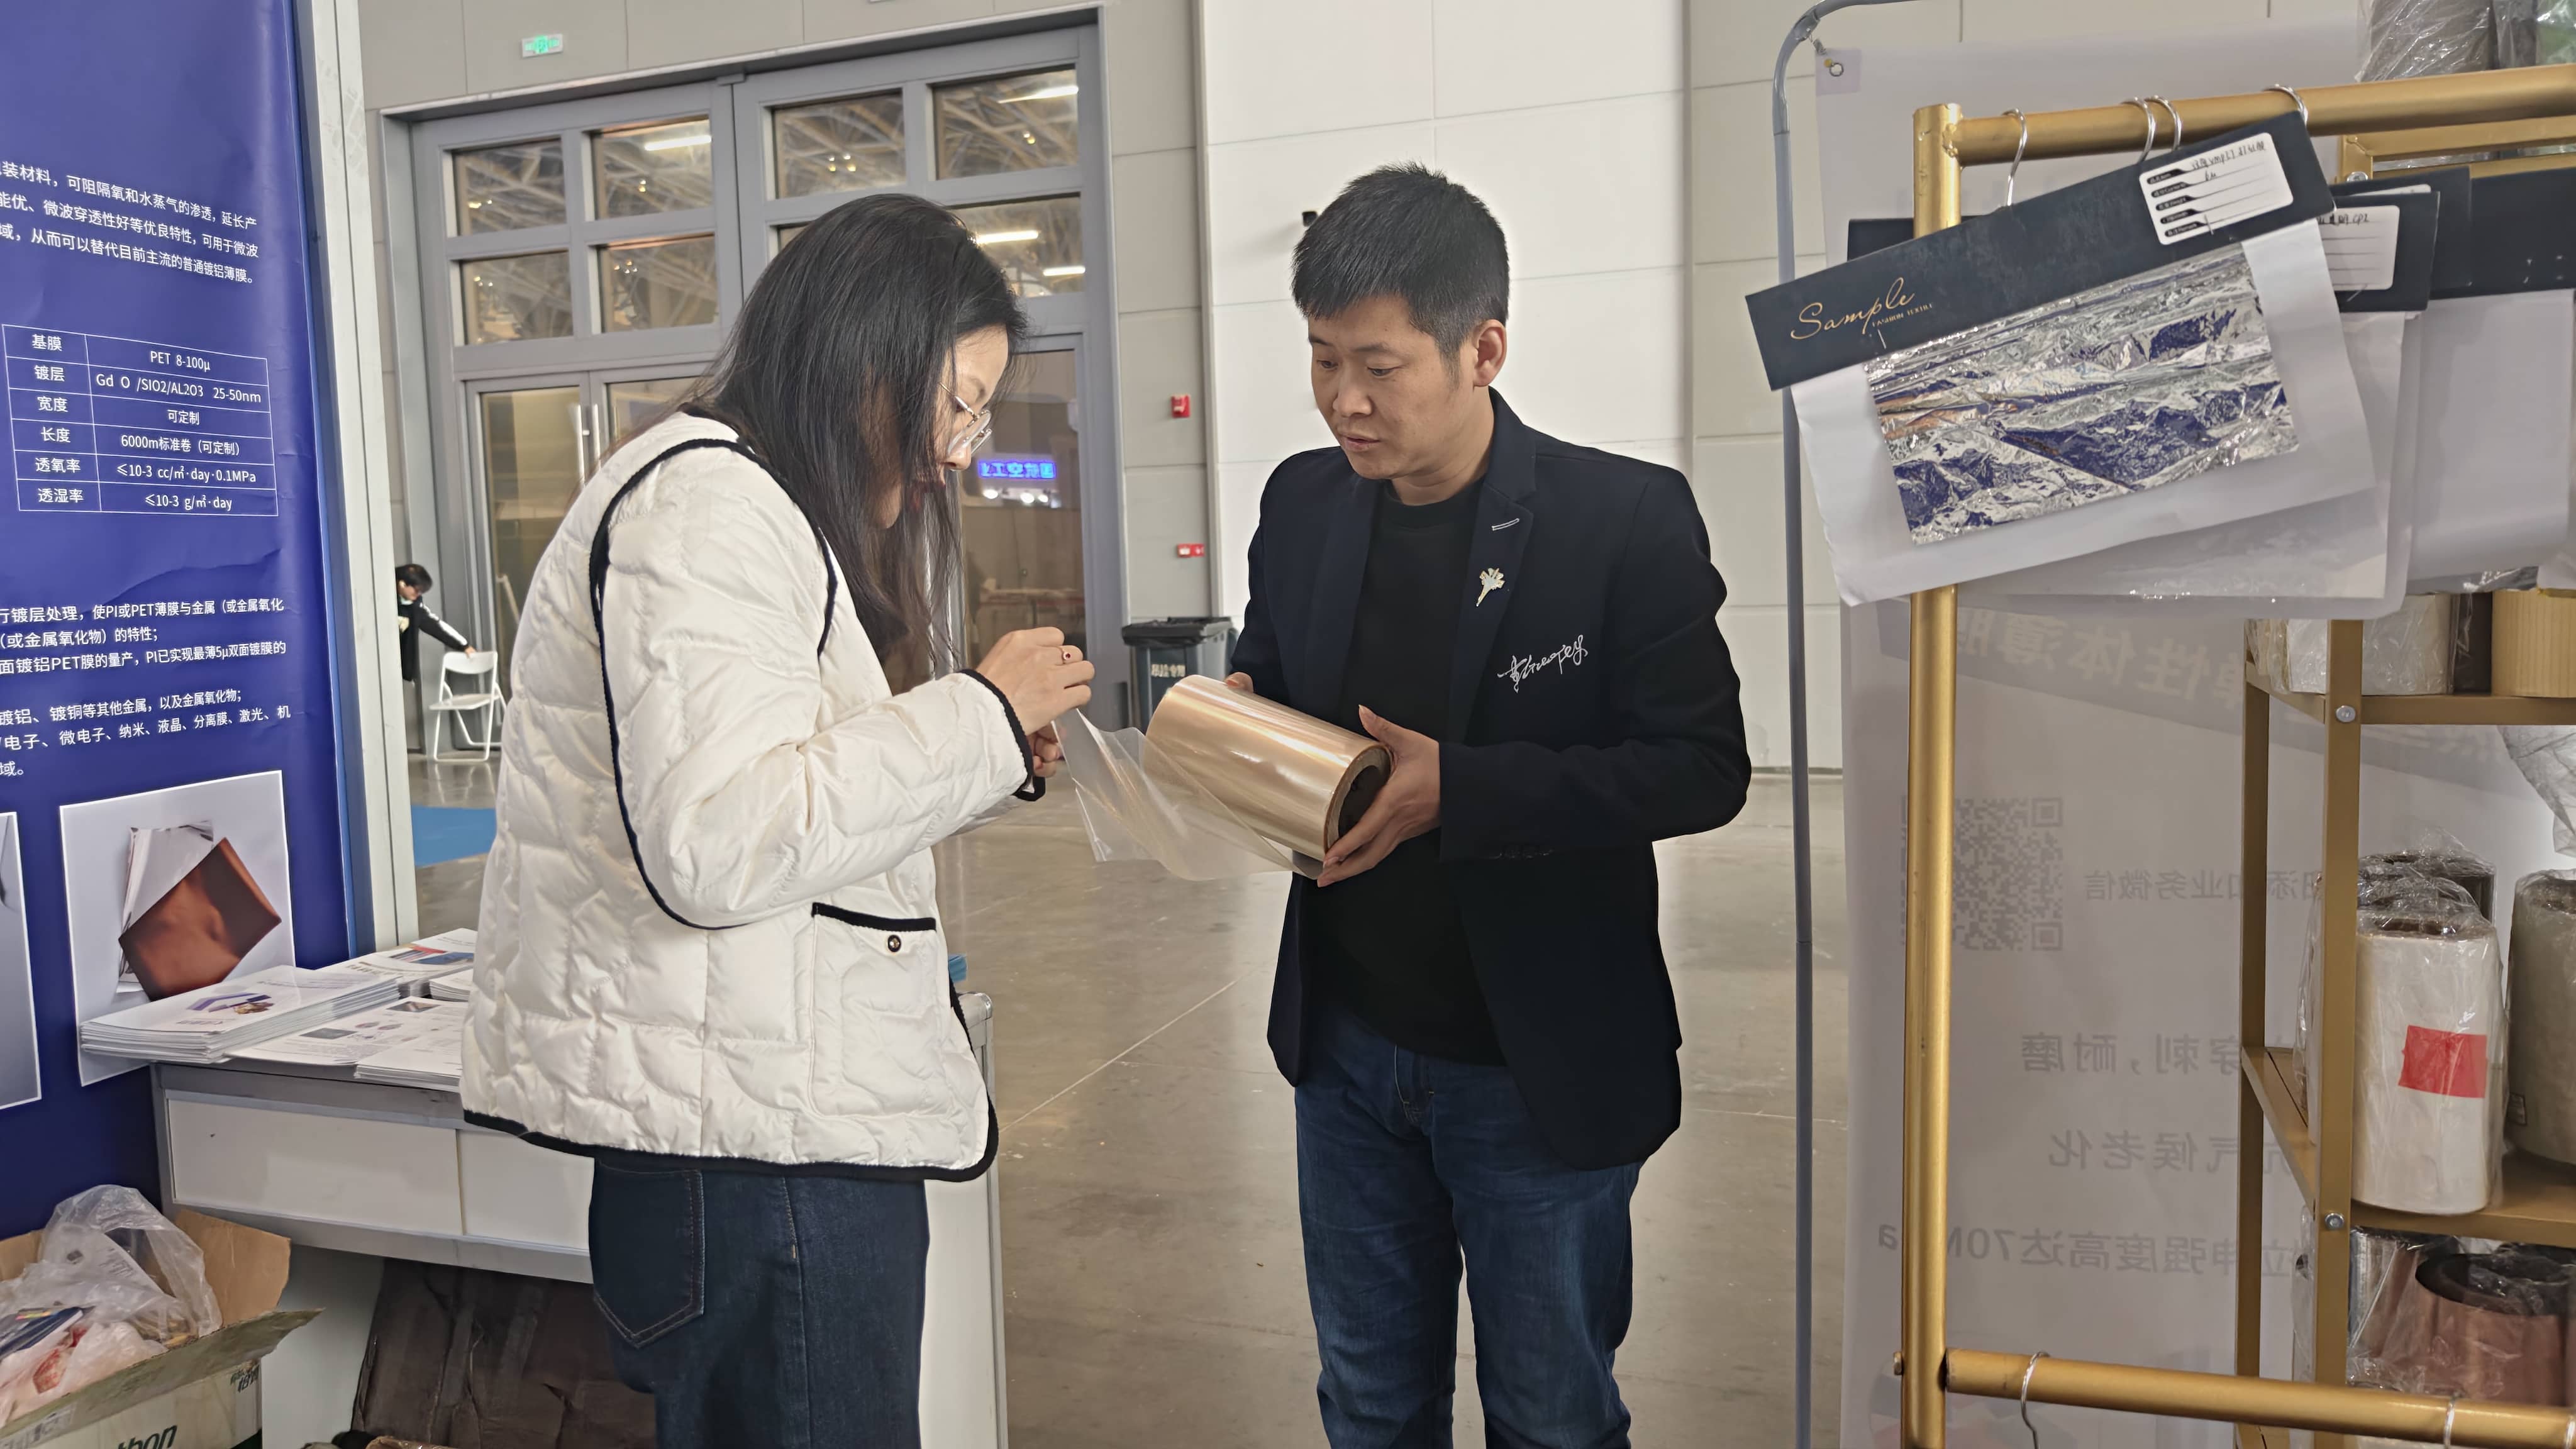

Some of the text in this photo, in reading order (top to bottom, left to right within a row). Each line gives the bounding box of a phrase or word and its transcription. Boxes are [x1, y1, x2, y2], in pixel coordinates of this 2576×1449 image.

[0, 160, 257, 230] 装材料，可阻隔氧和水蒸气的渗透，延长产
[1790, 277, 1915, 340] Sample
[32, 334, 62, 352] 基膜
[150, 350, 211, 372] PET 8-100μ
[34, 365, 65, 382] 镀层
[96, 374, 114, 387] Gd
[213, 387, 262, 403] 25-50nm
[38, 396, 68, 413] 宽度
[168, 409, 200, 425] 可定制
[41, 427, 71, 443] 长度
[35, 457, 81, 473] 透氧率
[38, 488, 84, 504] 透湿率
[0, 705, 291, 751] 电子、微电子、纳米、液晶、分离膜、激光、机
